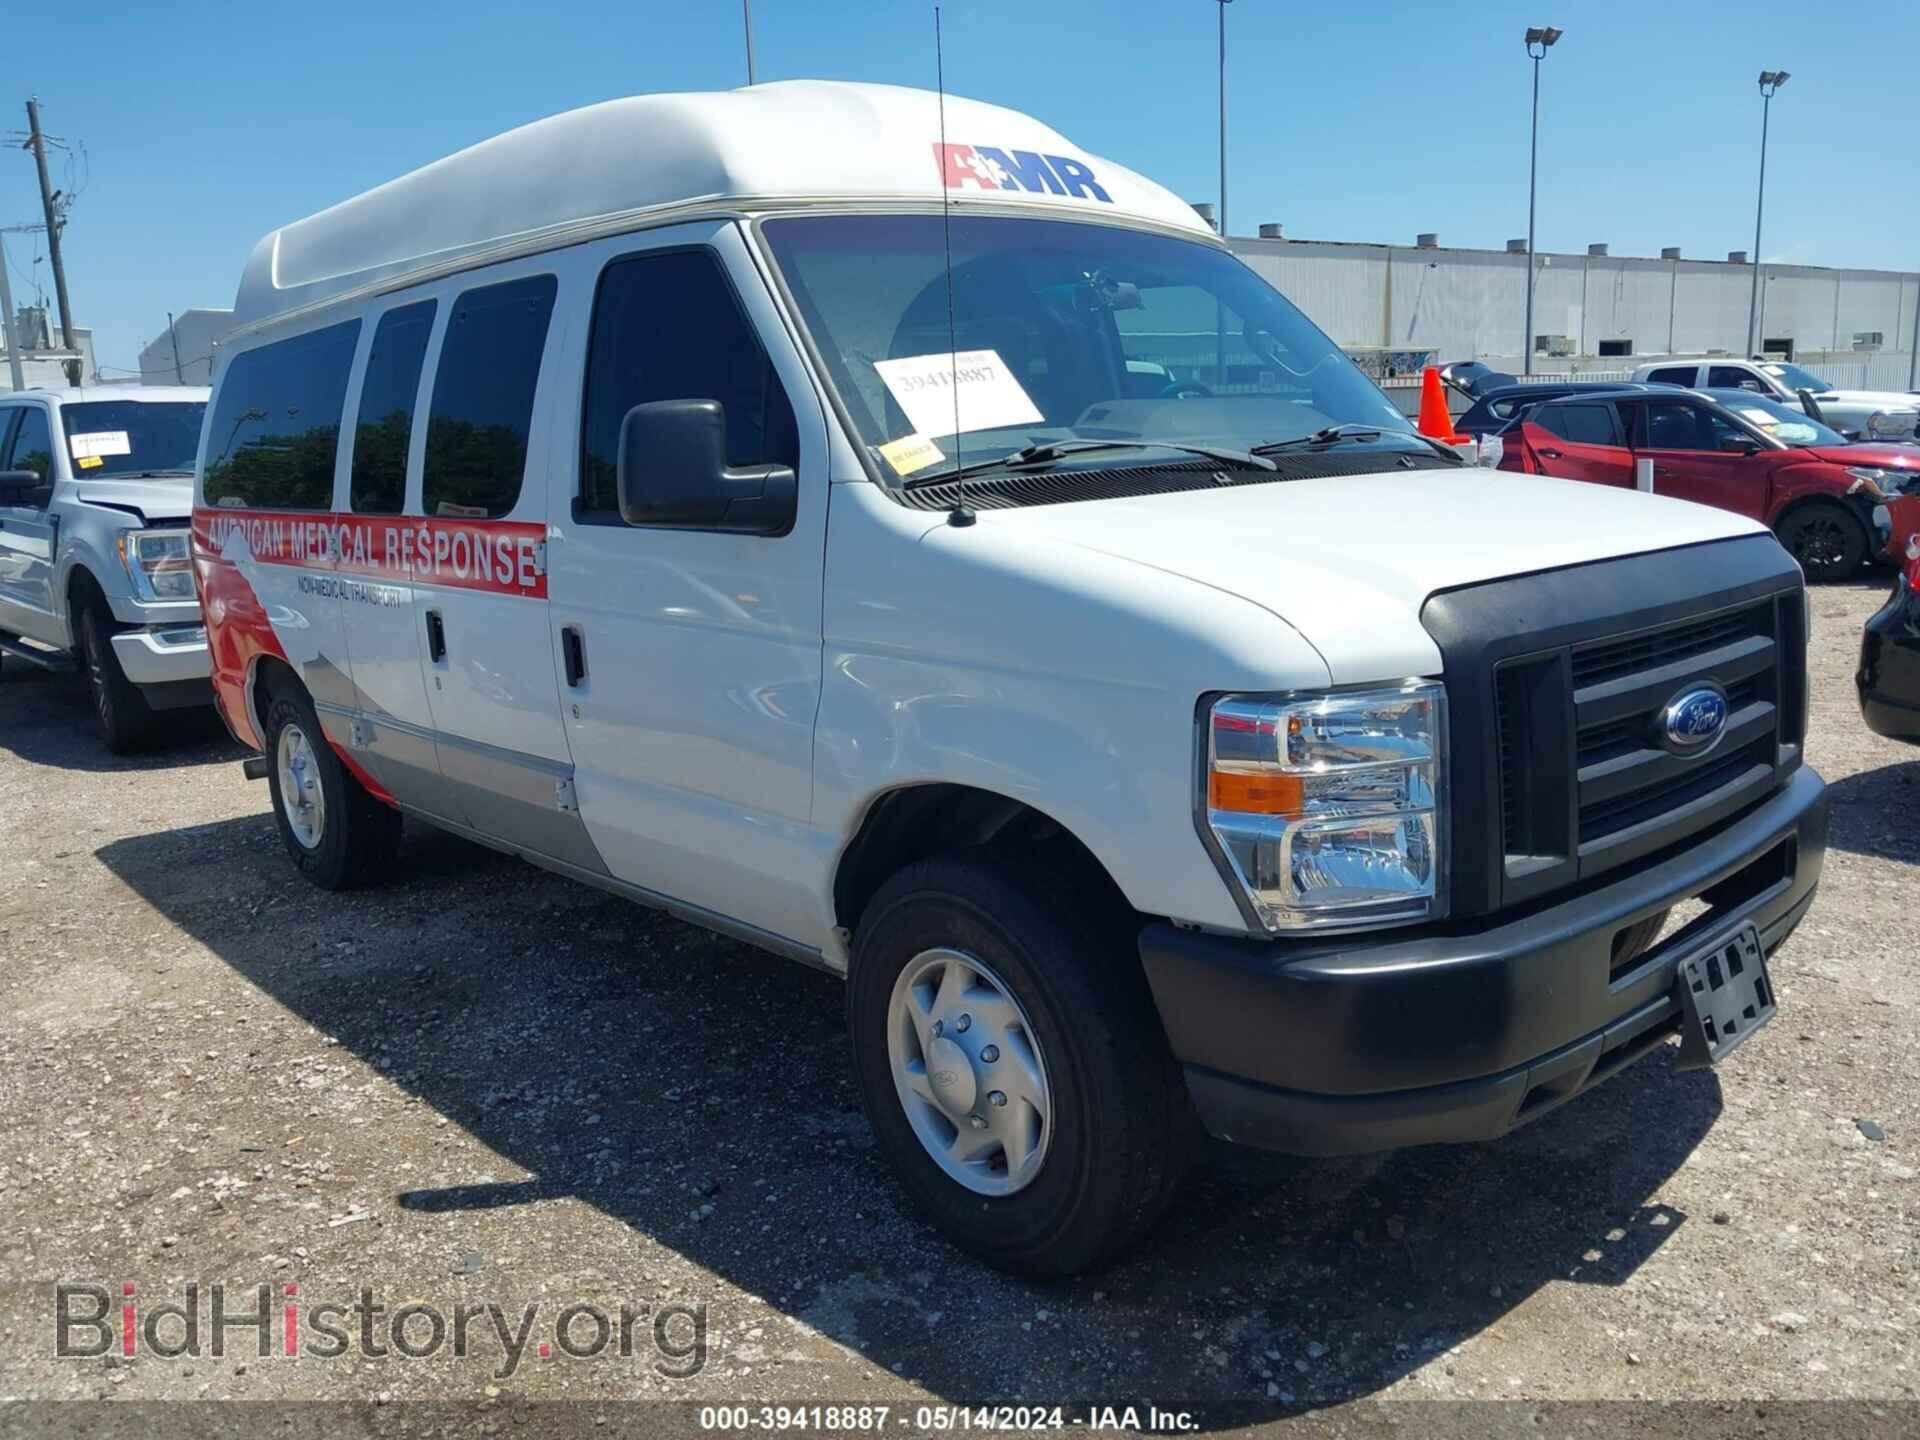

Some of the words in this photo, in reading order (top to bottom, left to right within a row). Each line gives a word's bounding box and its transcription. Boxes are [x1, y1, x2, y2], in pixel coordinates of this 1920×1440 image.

[932, 143, 1114, 203] AMR
[898, 365, 996, 393] 39418887
[385, 526, 537, 587] RESPONSE
[1686, 700, 1720, 736] Ford
